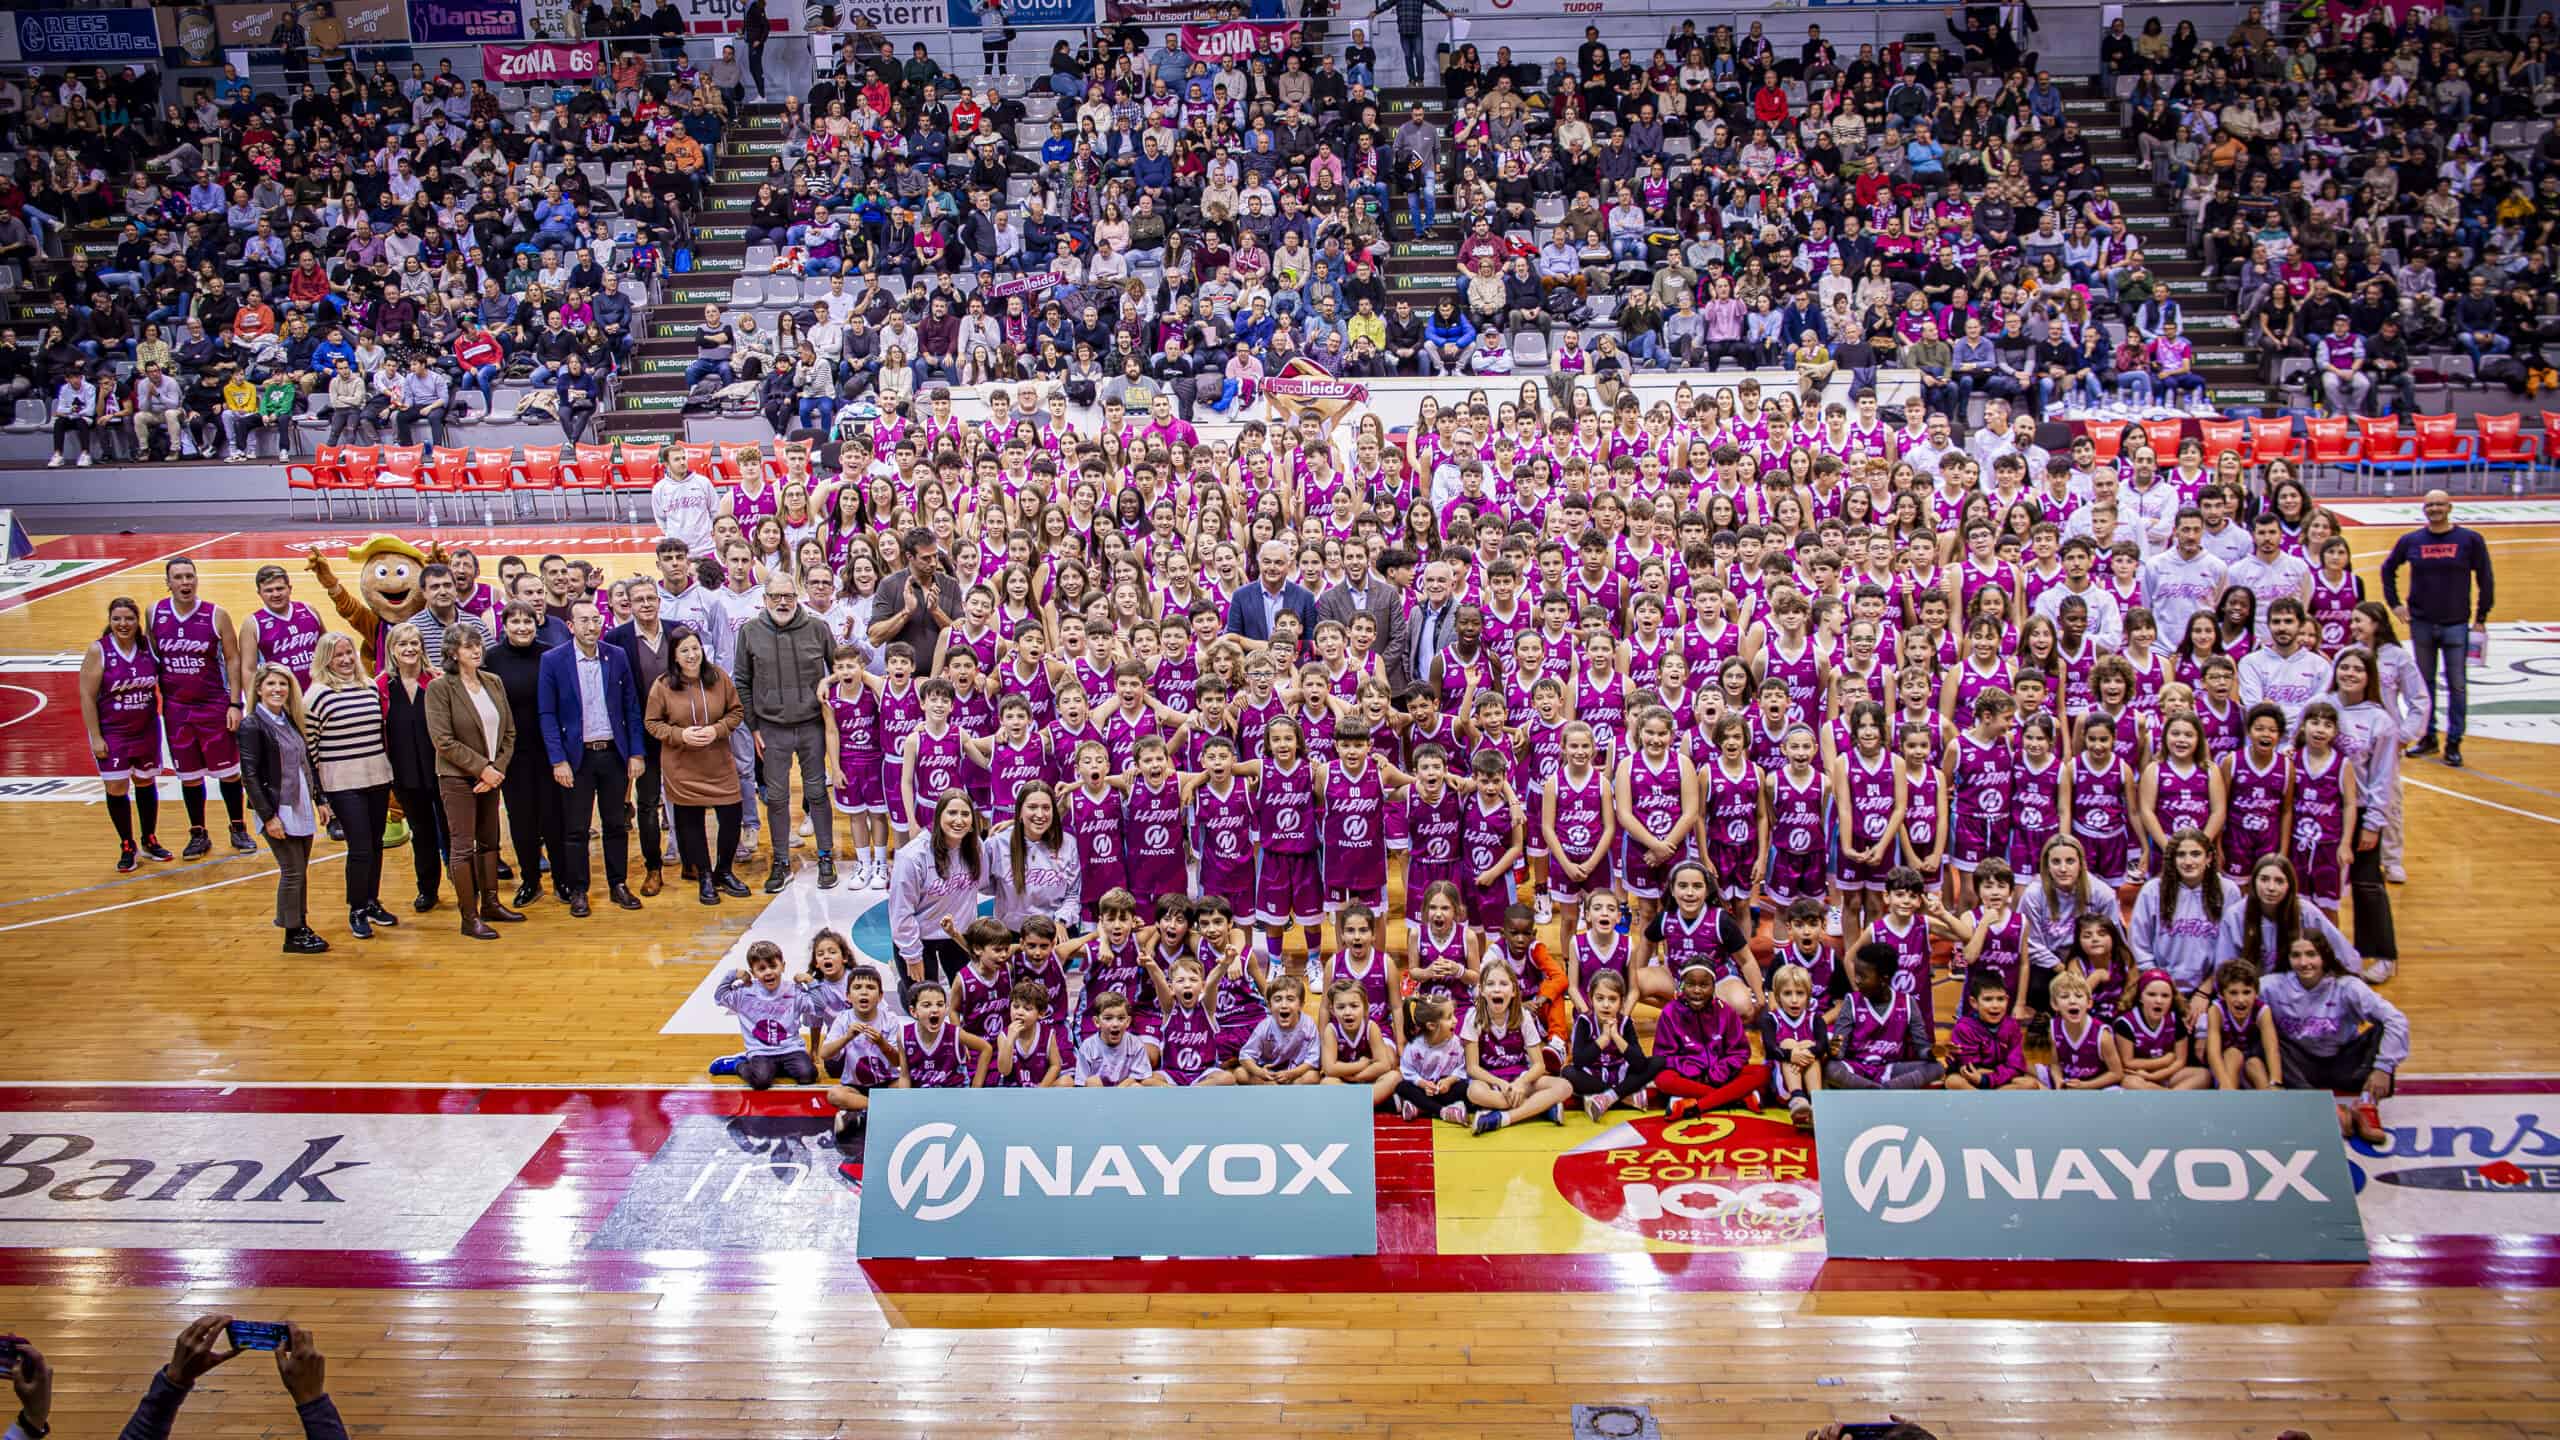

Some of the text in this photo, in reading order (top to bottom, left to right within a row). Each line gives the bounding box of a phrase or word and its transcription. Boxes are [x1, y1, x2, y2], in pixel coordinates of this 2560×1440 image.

[1563, 3, 1603, 12] TUDOR
[44, 15, 109, 33] REGS
[47, 33, 134, 53] GARCIA
[1197, 29, 1257, 56] ZONA
[499, 48, 557, 75] ZONA
[171, 655, 206, 668] atlas
[290, 652, 314, 668] atla
[1167, 1030, 1208, 1045] LLEIDA
[1605, 1148, 1809, 1165] RAMON
[0, 1133, 370, 1204] Bank
[1002, 1143, 1353, 1197] NAYOX
[1616, 1165, 1808, 1182] SOLER
[1961, 1147, 2332, 1202] NAYOX
[1622, 1183, 1822, 1220] 100
